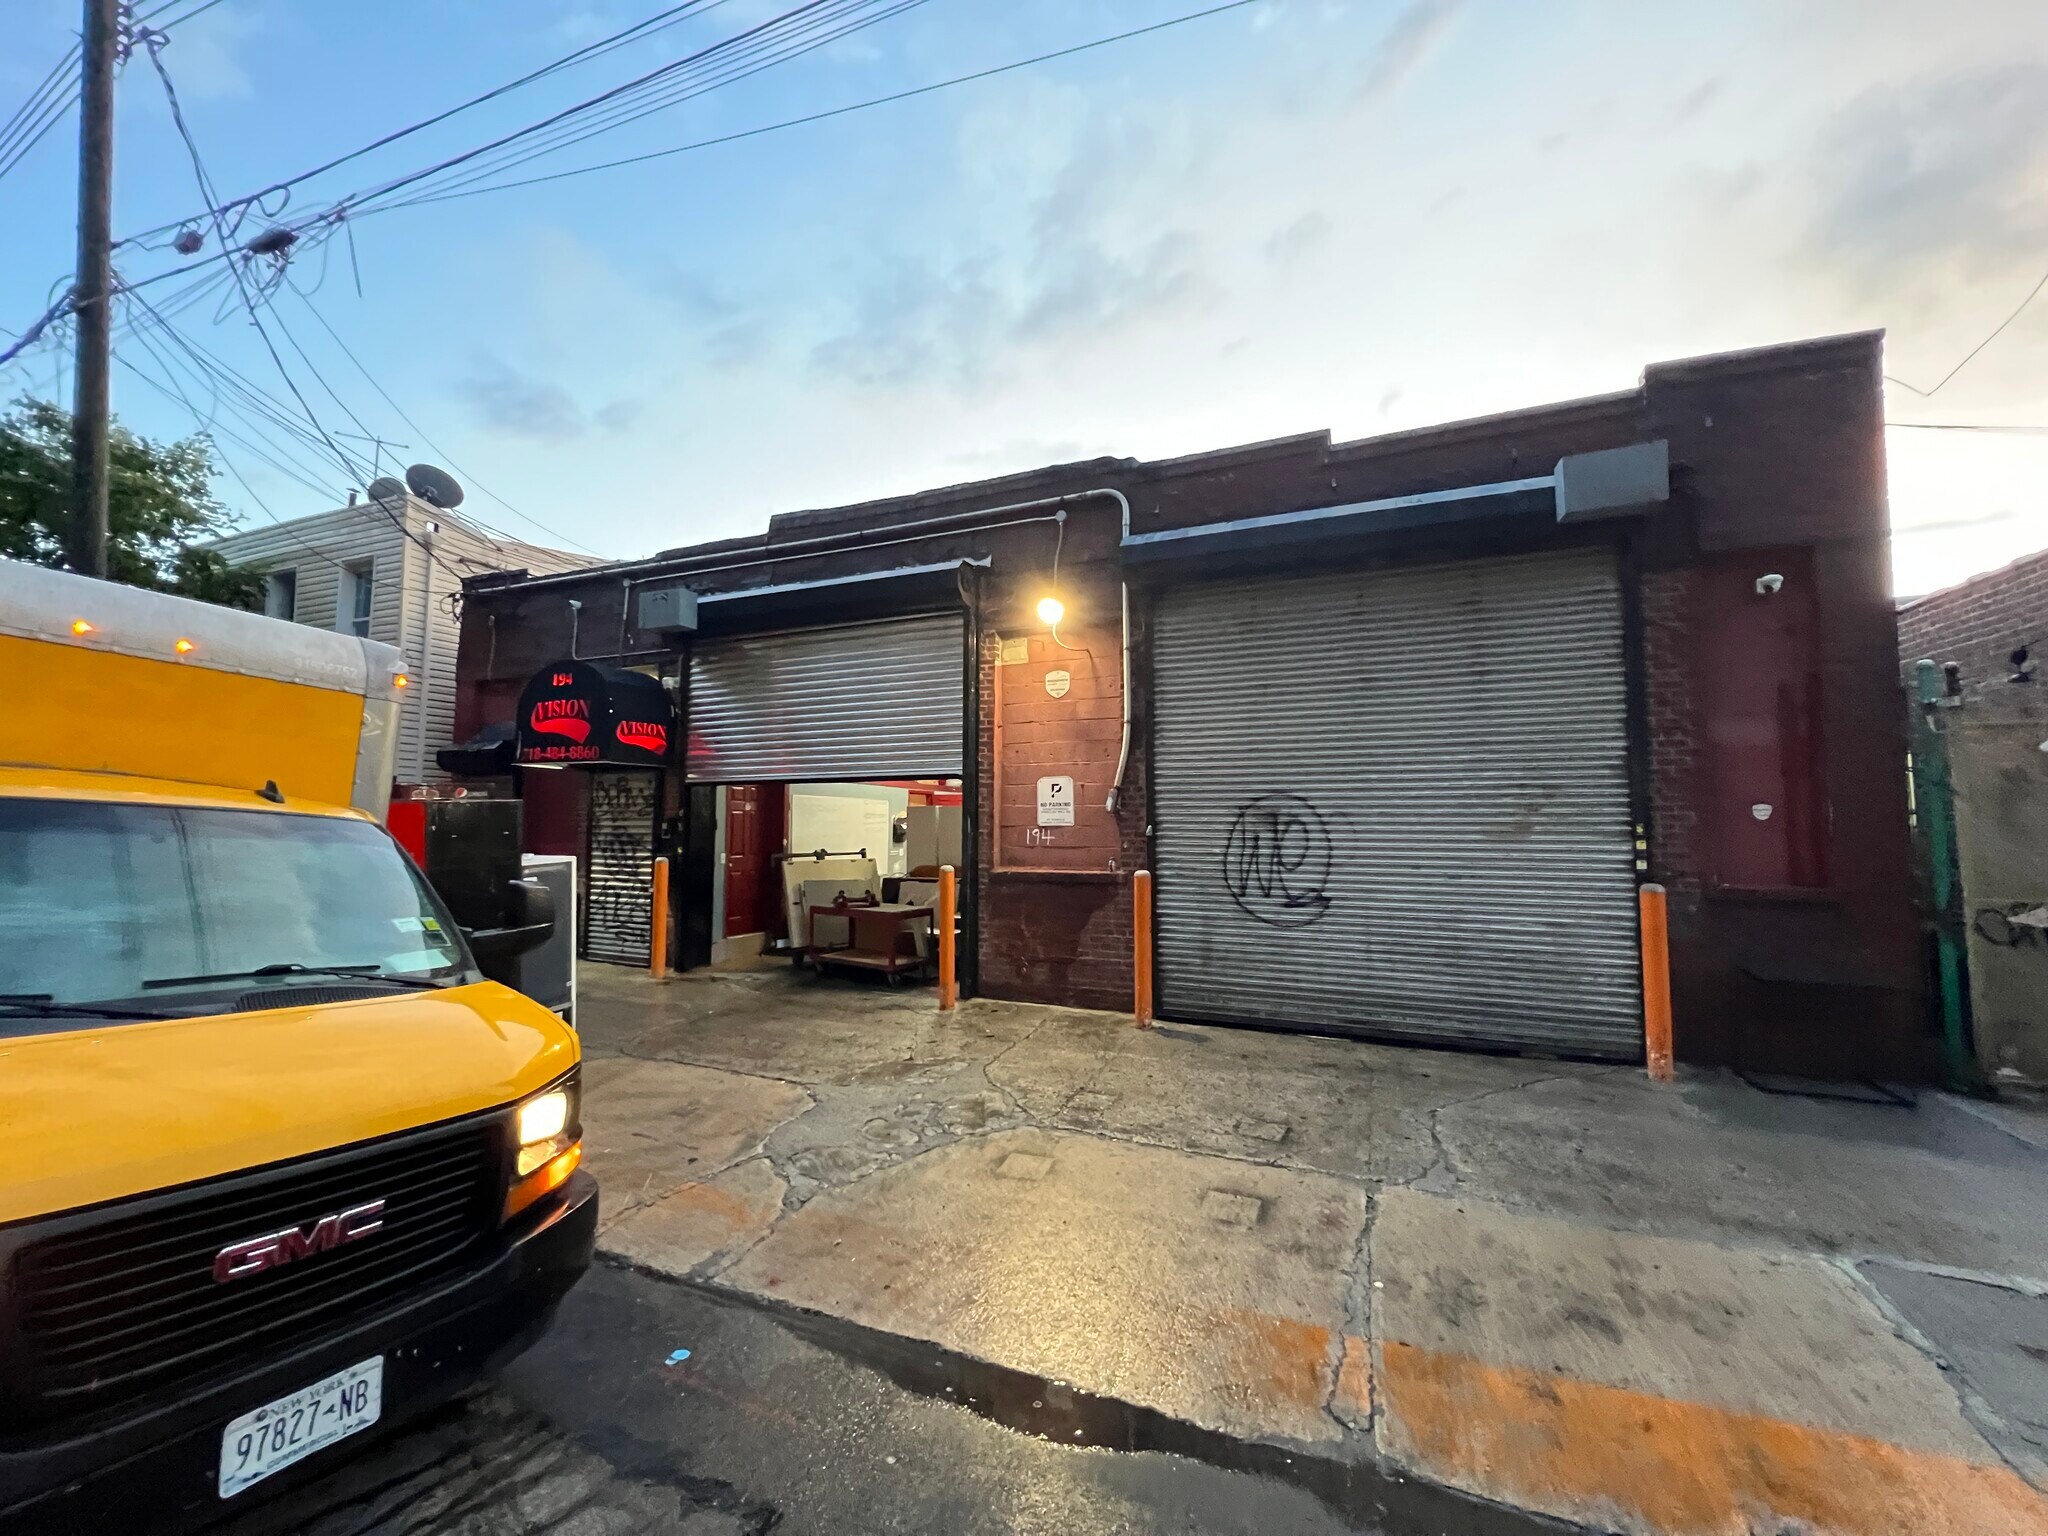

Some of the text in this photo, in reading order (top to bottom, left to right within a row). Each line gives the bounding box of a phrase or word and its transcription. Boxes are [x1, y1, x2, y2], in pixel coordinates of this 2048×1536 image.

[552, 672, 573, 686] 194
[537, 699, 589, 720] VISION
[621, 720, 667, 740] VISION
[1026, 828, 1056, 845] 194
[213, 1200, 385, 1284] GMC
[268, 1378, 345, 1418] NEW YORK
